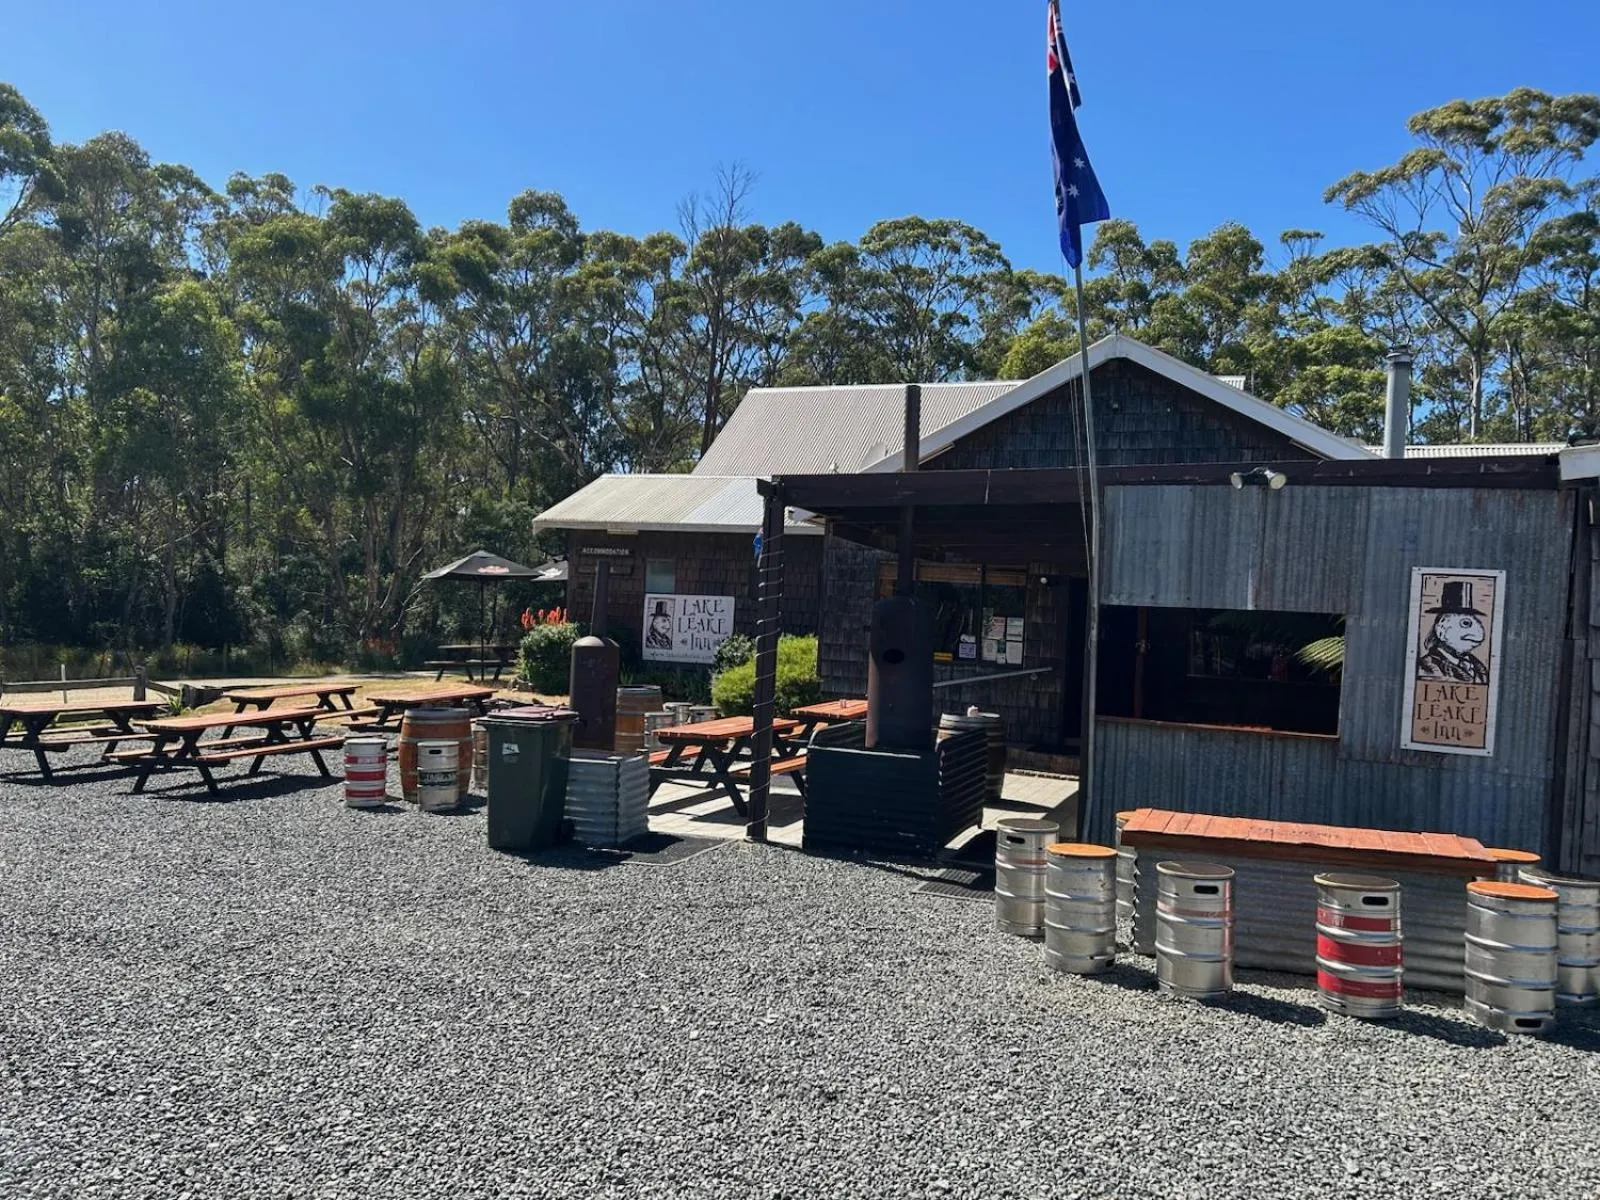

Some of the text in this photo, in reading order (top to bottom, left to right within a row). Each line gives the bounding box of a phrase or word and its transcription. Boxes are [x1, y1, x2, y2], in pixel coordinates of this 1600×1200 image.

[582, 547, 630, 556] ACCOMMODATION
[682, 599, 725, 617] LAKE
[678, 617, 728, 635] LEAKE
[690, 633, 712, 651] Inn
[1423, 684, 1480, 704] LAKE
[1416, 703, 1484, 725] LEAKE
[1434, 721, 1462, 741] Inn
